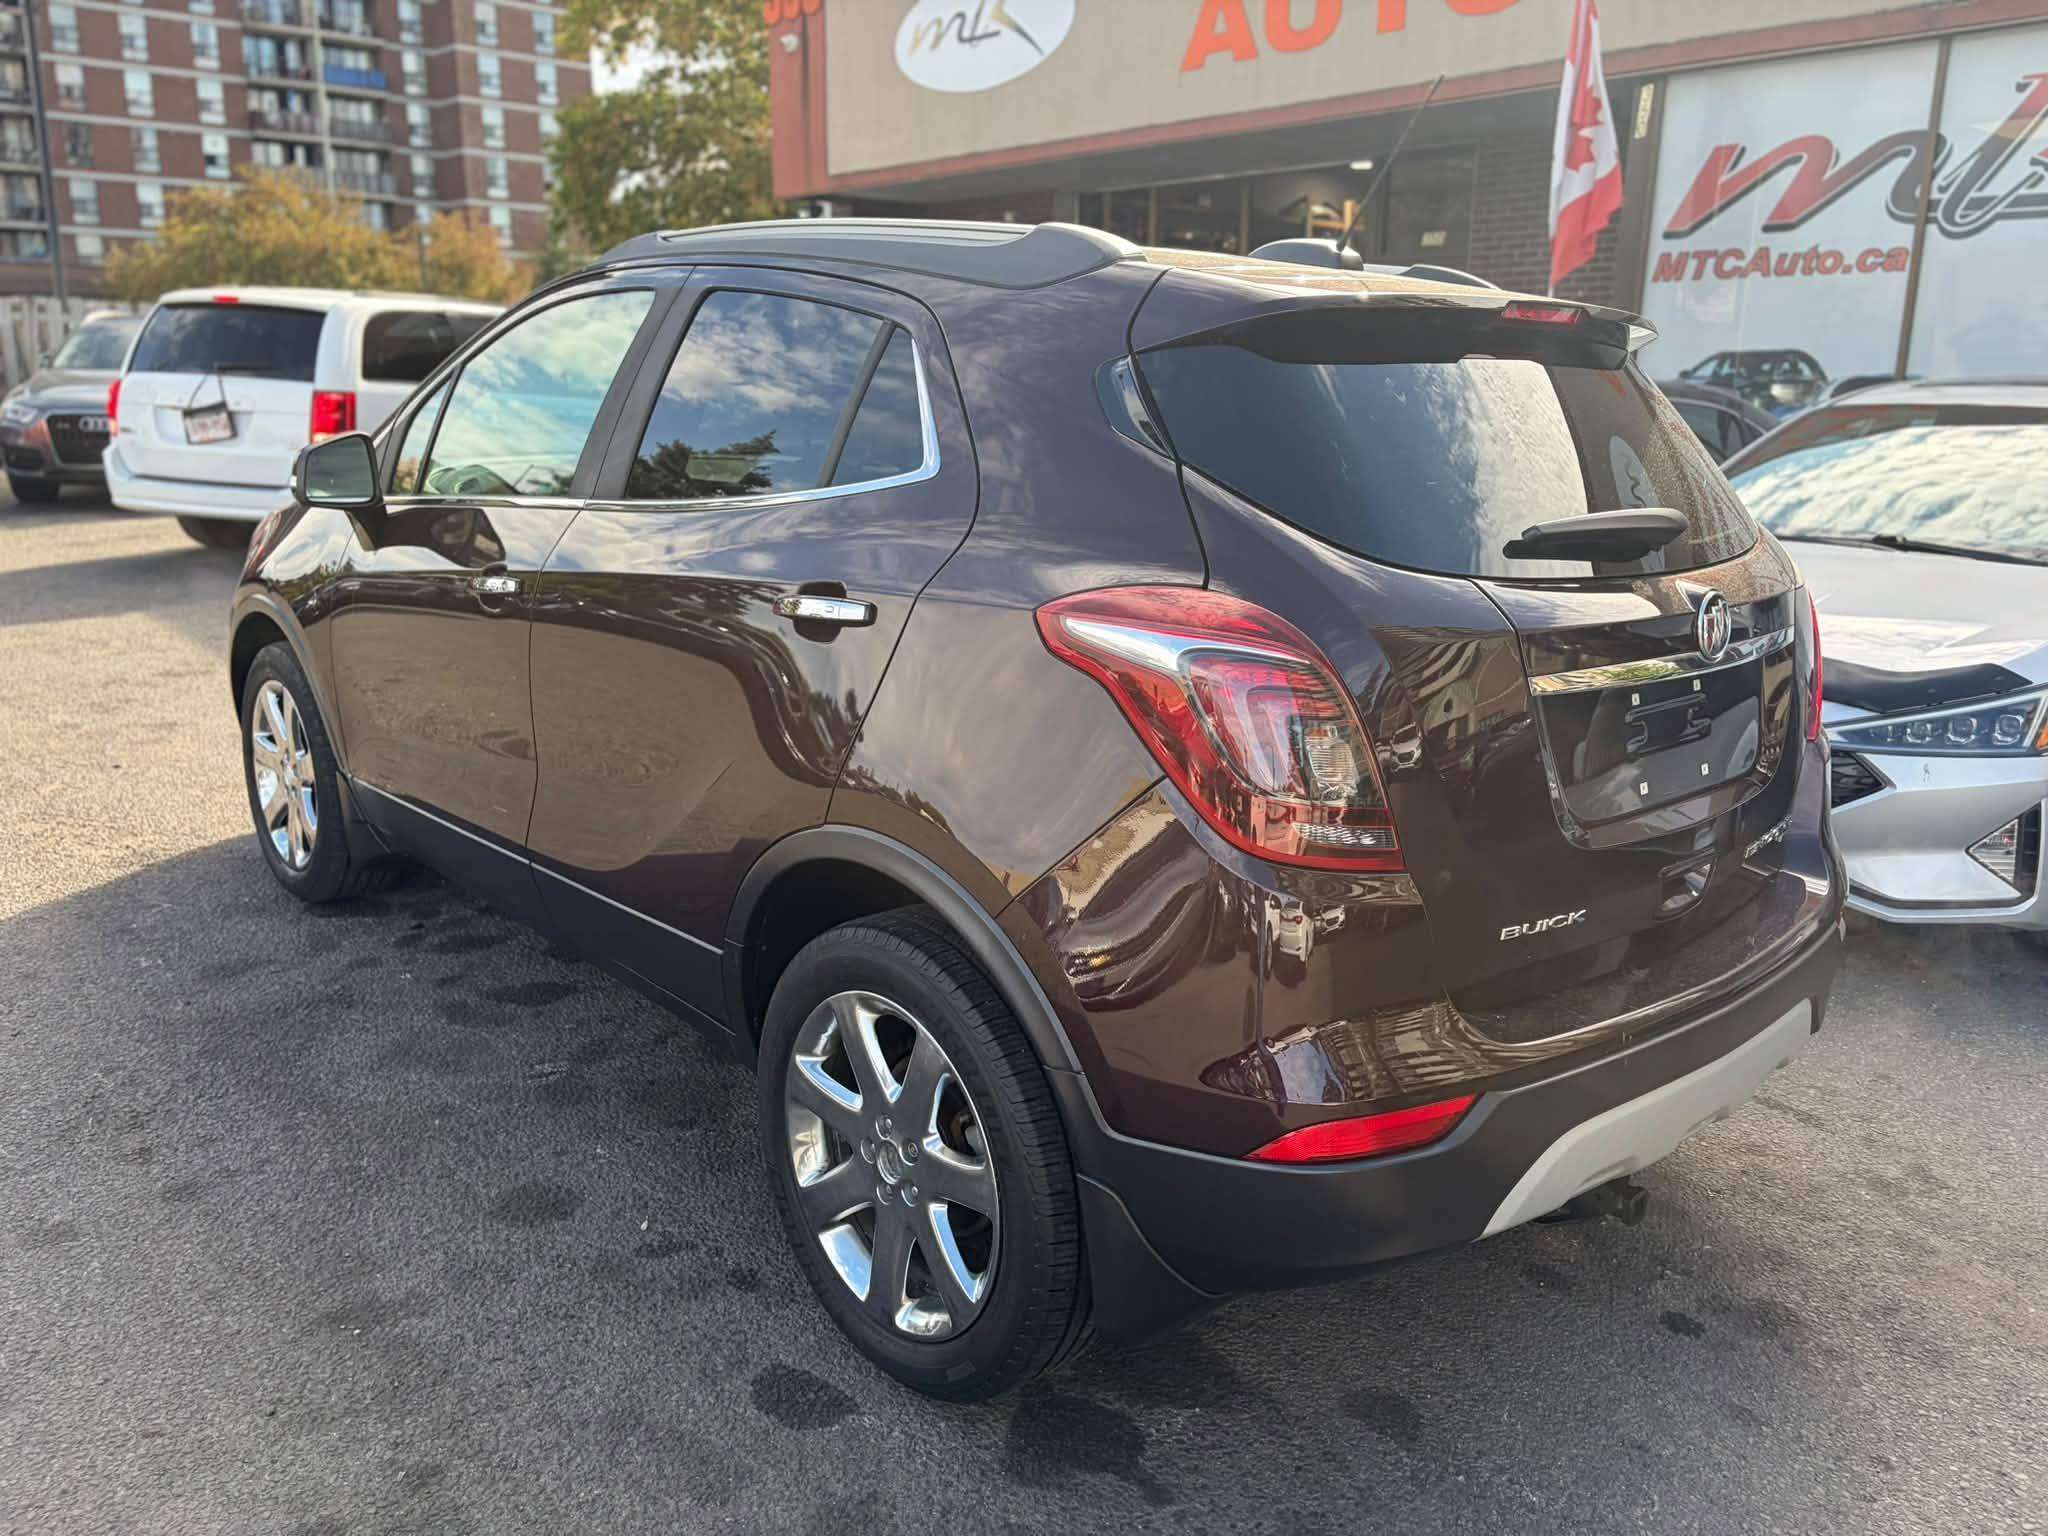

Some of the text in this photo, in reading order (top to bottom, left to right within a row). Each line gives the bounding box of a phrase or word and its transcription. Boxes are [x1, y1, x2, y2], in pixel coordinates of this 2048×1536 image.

[1179, 0, 1520, 73] AU
[1651, 245, 1910, 283] MTCAuto.ca
[1500, 909, 1587, 941] BUICK
